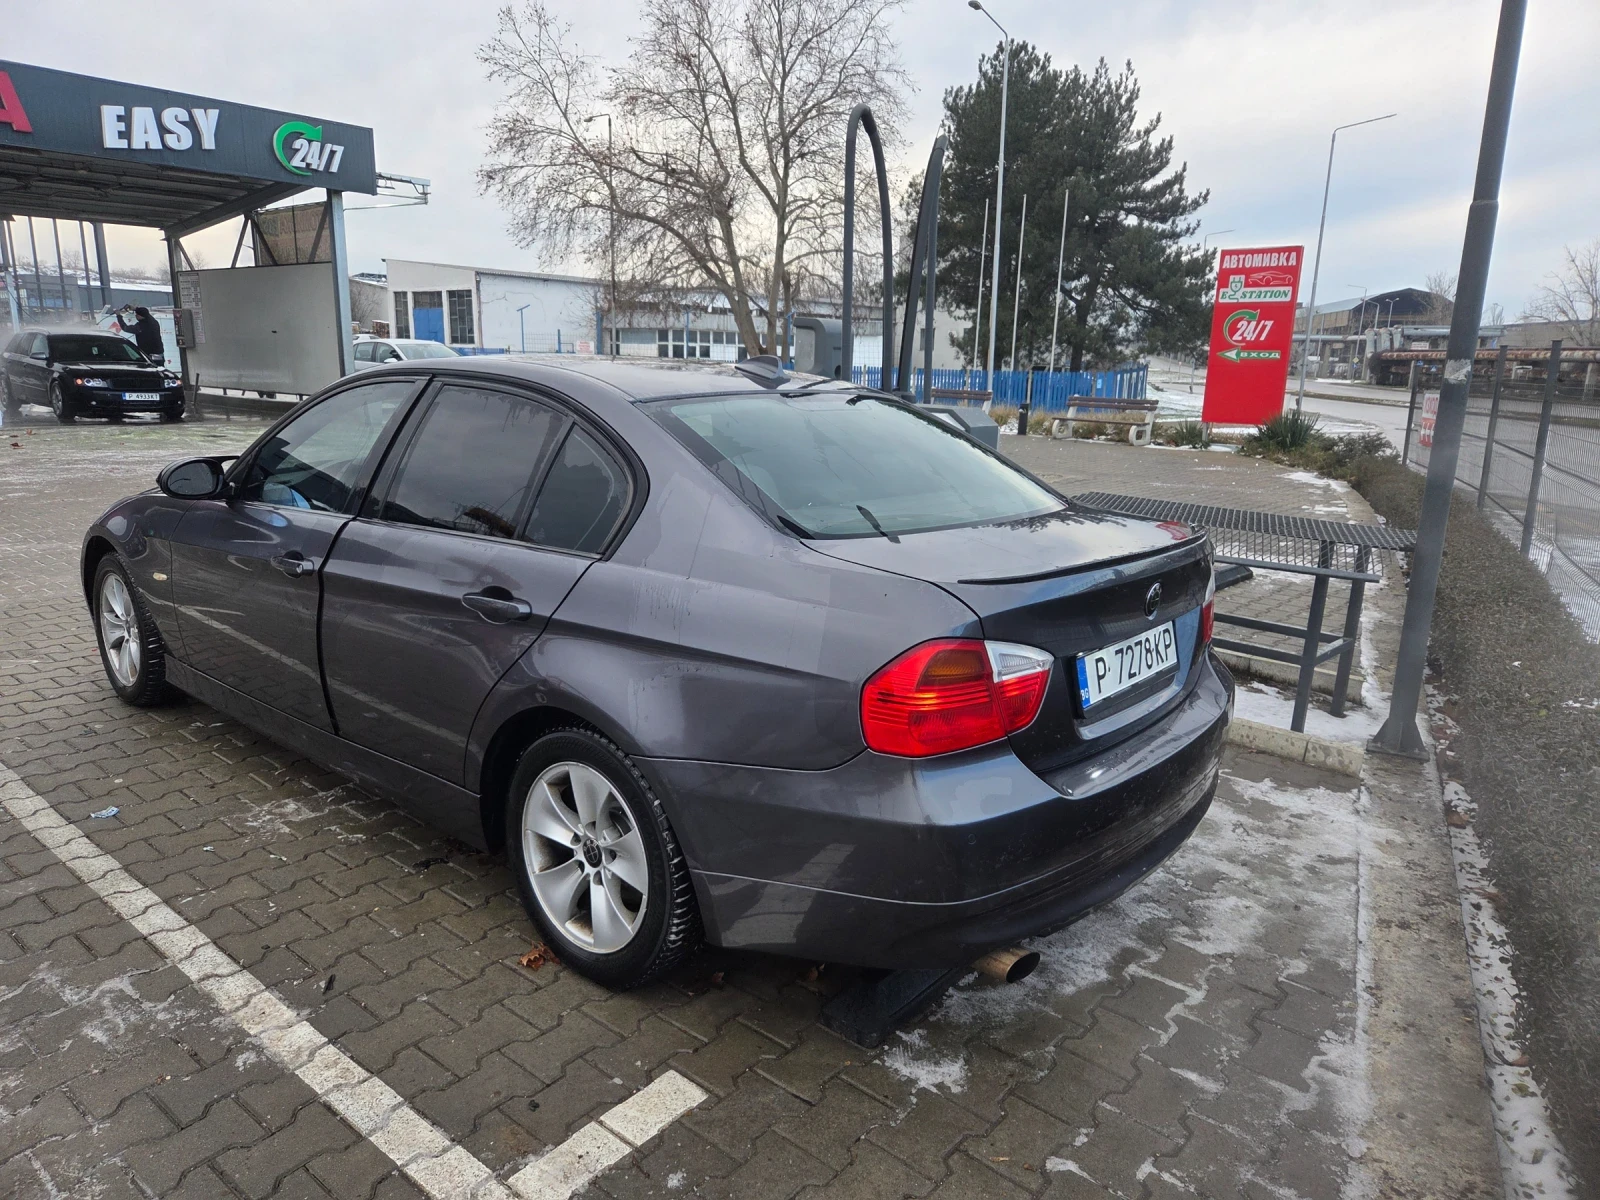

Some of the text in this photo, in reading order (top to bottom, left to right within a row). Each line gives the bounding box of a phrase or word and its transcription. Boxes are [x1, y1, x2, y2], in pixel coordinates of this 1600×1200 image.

[100, 104, 220, 151] EASY
[289, 138, 345, 173] 24/7
[1222, 252, 1297, 269] АВТОМИВКА
[1240, 289, 1291, 300] STATION
[1232, 320, 1275, 341] 24/7
[1240, 351, 1280, 359] ВХОД
[1095, 656, 1107, 694] P
[1080, 688, 1089, 700] BG
